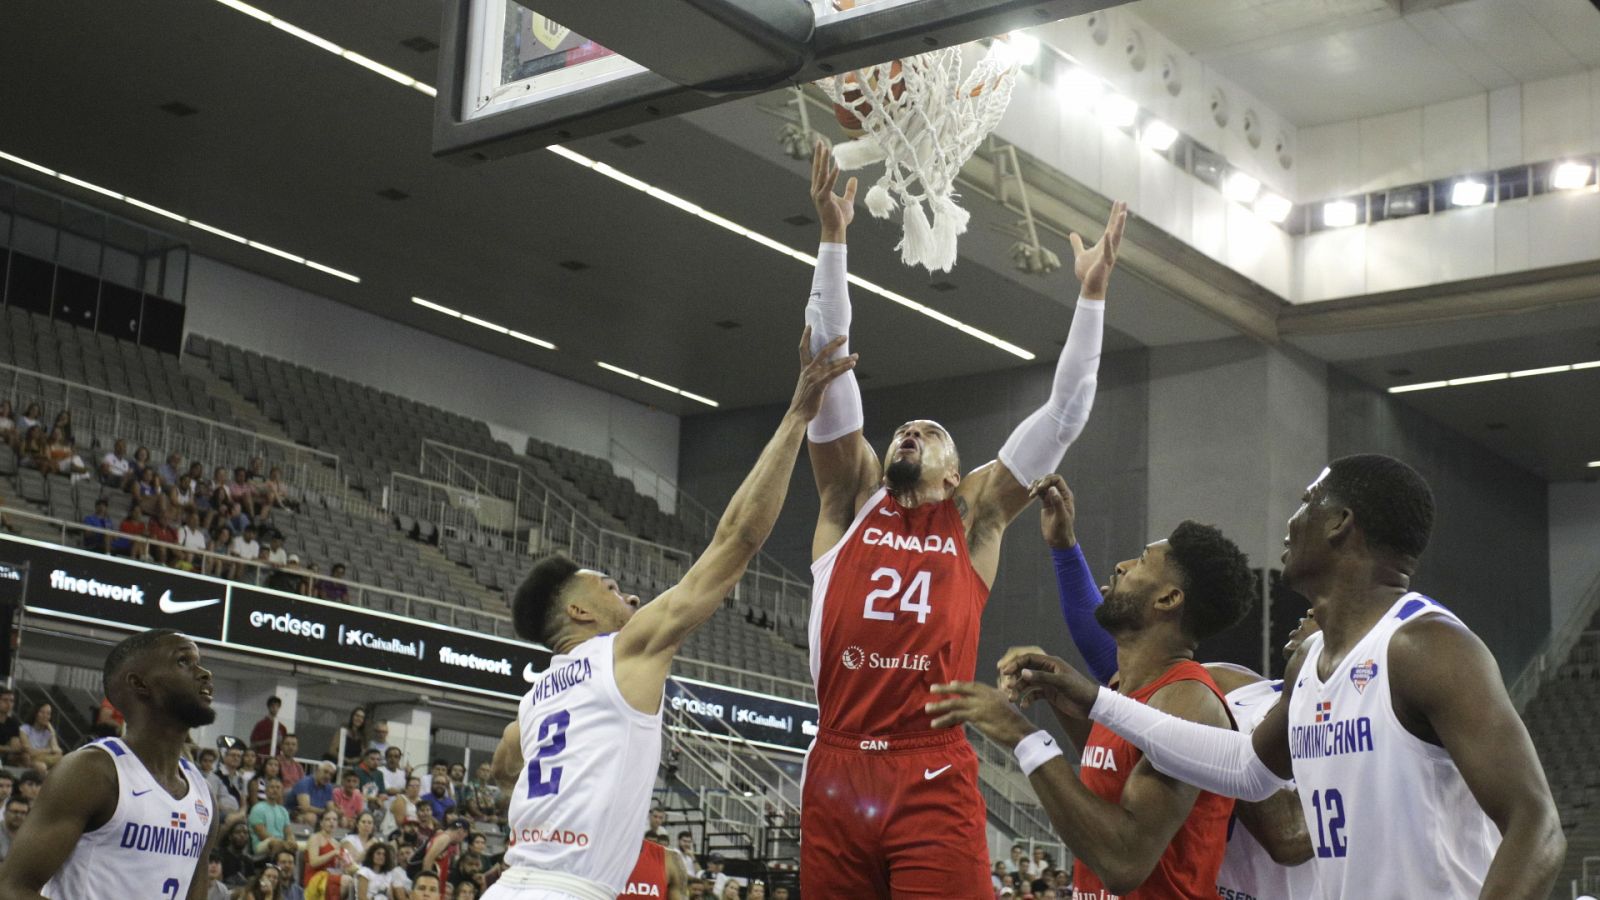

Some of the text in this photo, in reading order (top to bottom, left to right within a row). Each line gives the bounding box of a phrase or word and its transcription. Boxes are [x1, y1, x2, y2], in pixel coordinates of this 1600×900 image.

[862, 527, 958, 557] CANADA
[50, 569, 145, 605] finetwork
[863, 567, 932, 624] 24
[250, 610, 326, 640] endesa
[439, 646, 512, 676] finetwork
[869, 652, 931, 671] Sun Life
[532, 657, 593, 706] MENDOZA
[527, 709, 571, 800] 2
[860, 740, 888, 750] CAN
[1291, 716, 1374, 759] DOMINICANA
[1312, 788, 1348, 858] 12
